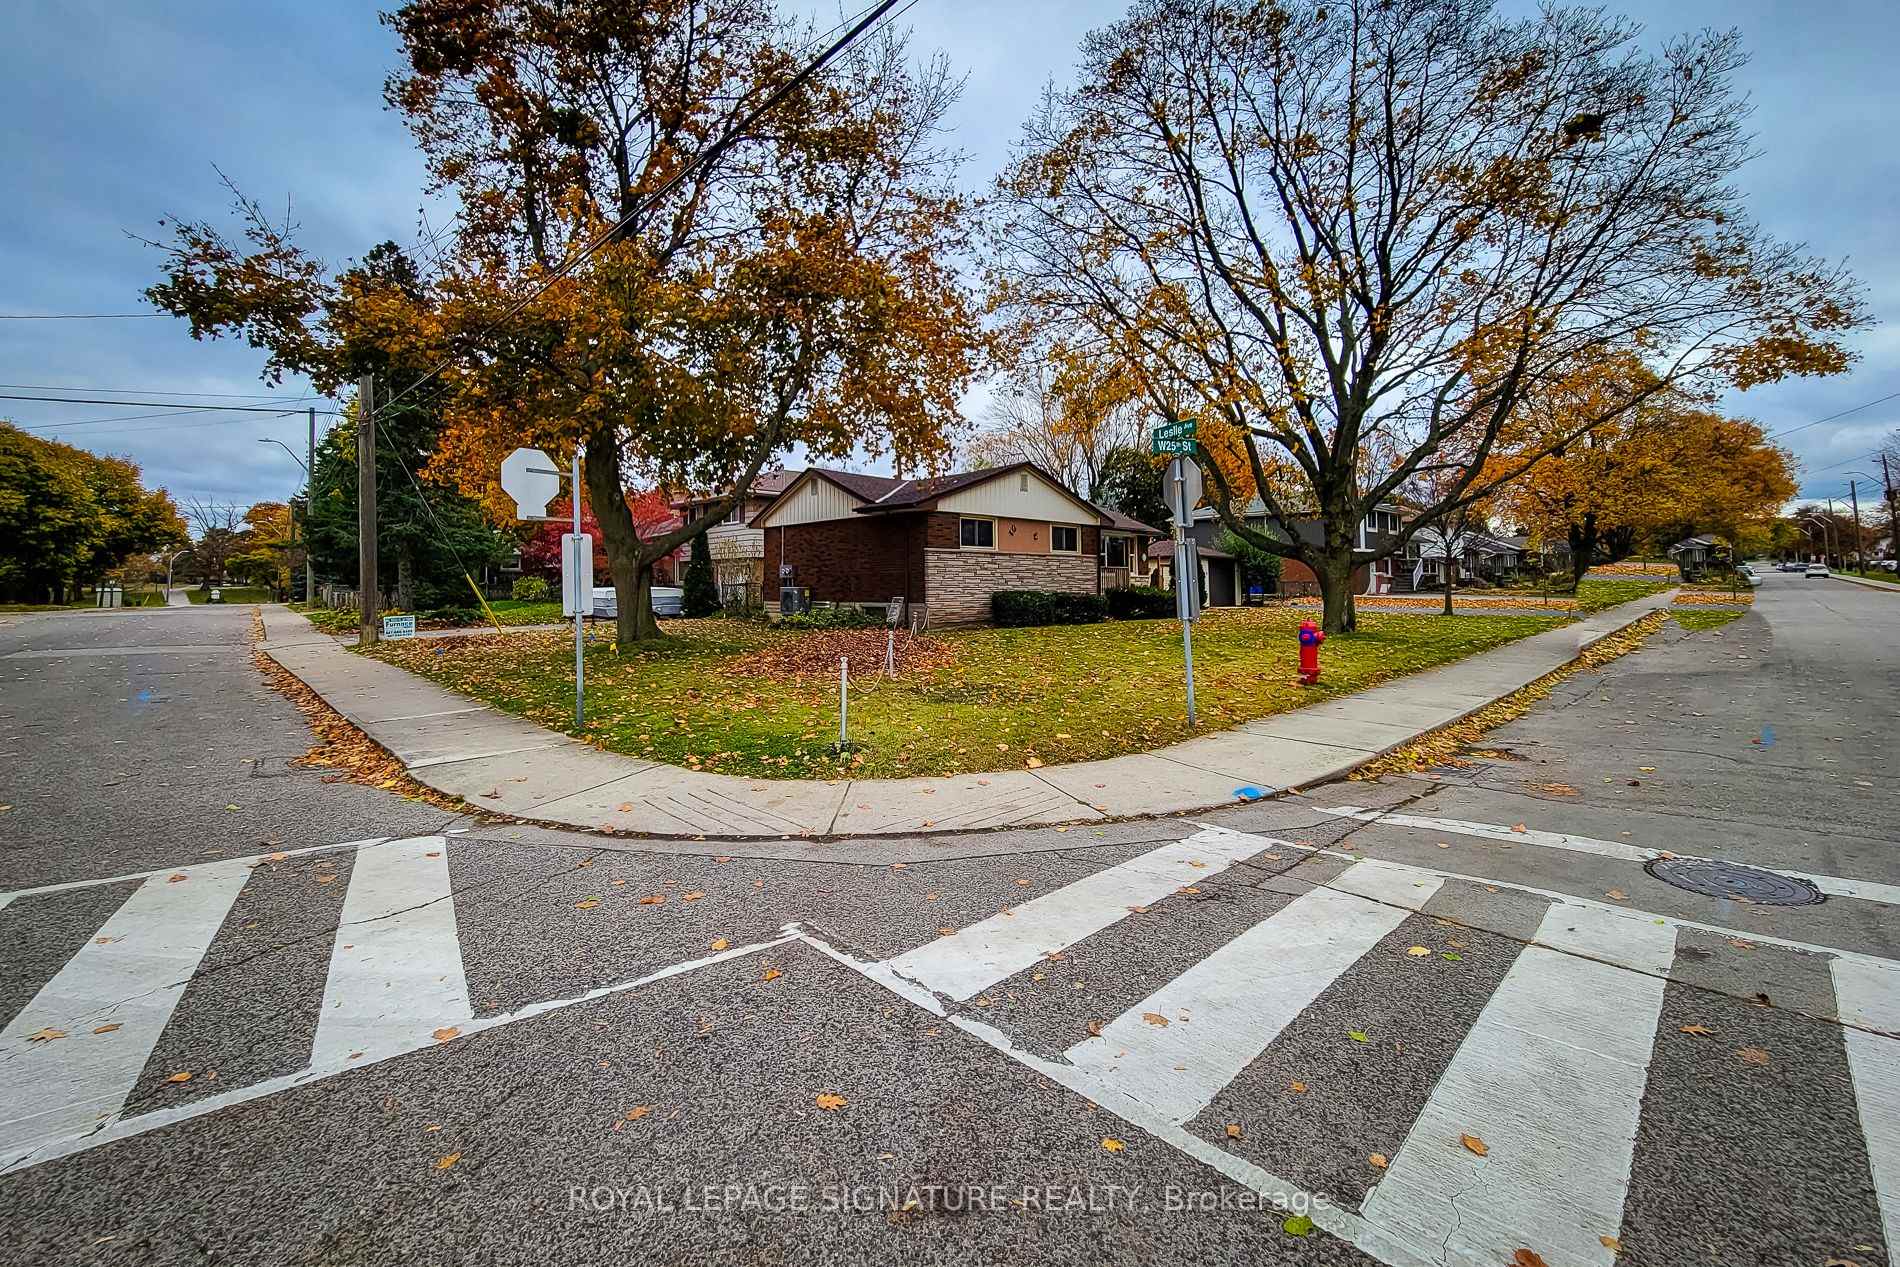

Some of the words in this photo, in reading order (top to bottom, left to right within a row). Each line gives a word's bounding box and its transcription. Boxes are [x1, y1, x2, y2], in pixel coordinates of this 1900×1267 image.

[1158, 424, 1183, 439] Leslie
[1184, 422, 1193, 430] Ave
[1182, 440, 1192, 452] St
